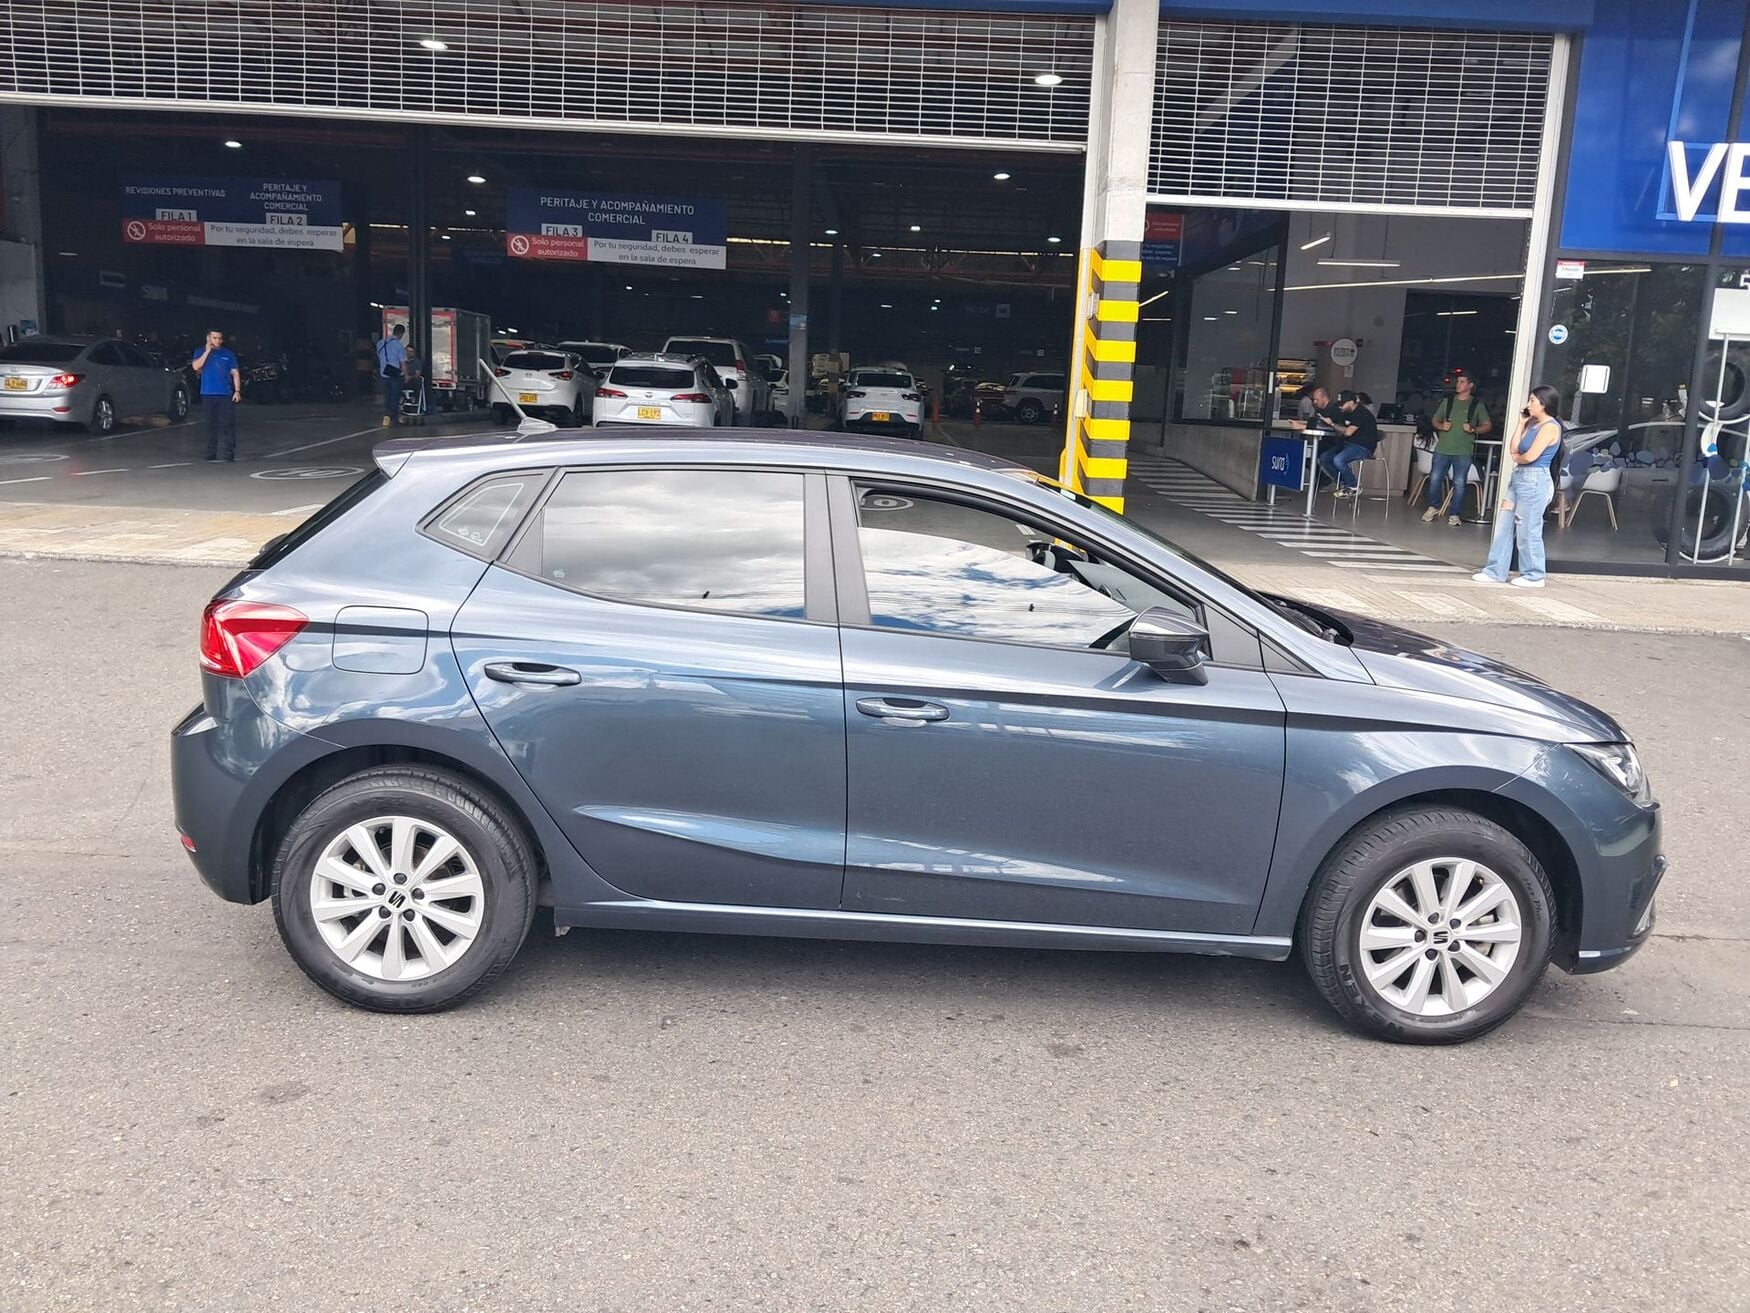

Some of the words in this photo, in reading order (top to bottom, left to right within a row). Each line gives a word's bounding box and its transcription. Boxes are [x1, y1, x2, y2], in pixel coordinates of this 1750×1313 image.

[263, 183, 301, 192] PERITAJE
[301, 184, 308, 192] Y
[1667, 140, 1750, 224] VE
[125, 186, 172, 196] REVISIONES
[172, 188, 226, 198] PREVENTIVAS
[250, 191, 322, 202] ACOMPAÑAMIENTO
[263, 201, 309, 211] COMERCIAL
[540, 196, 589, 209] PERITAJE
[591, 200, 599, 209] Y
[600, 200, 695, 216] ACOMPAÑAMIENTO
[160, 211, 185, 221] FILA
[270, 215, 294, 226] FILA
[296, 216, 304, 226] 2
[587, 212, 647, 225] COMERCIAL
[148, 222, 166, 231] Solo
[166, 223, 201, 233] personal
[210, 225, 224, 233] Por
[224, 225, 234, 233] tu
[278, 226, 304, 235] debes
[306, 229, 338, 239] esperar
[545, 226, 570, 237] FILA
[571, 227, 579, 237] 3
[154, 234, 196, 242] autorizado
[236, 237, 248, 245] en
[257, 237, 274, 245] sala
[274, 237, 286, 246] de
[287, 239, 315, 248] espera
[531, 236, 550, 247] Solo
[551, 239, 585, 250] personal
[655, 232, 681, 244] FILA
[682, 234, 690, 245] 4
[537, 248, 580, 258] autorizado
[593, 240, 608, 249] Por
[608, 241, 617, 249] tu
[661, 244, 686, 254] debes
[689, 247, 720, 258] esperar
[618, 253, 630, 261] en
[639, 253, 656, 262] sala
[657, 254, 669, 263] de
[669, 256, 697, 266] espera
